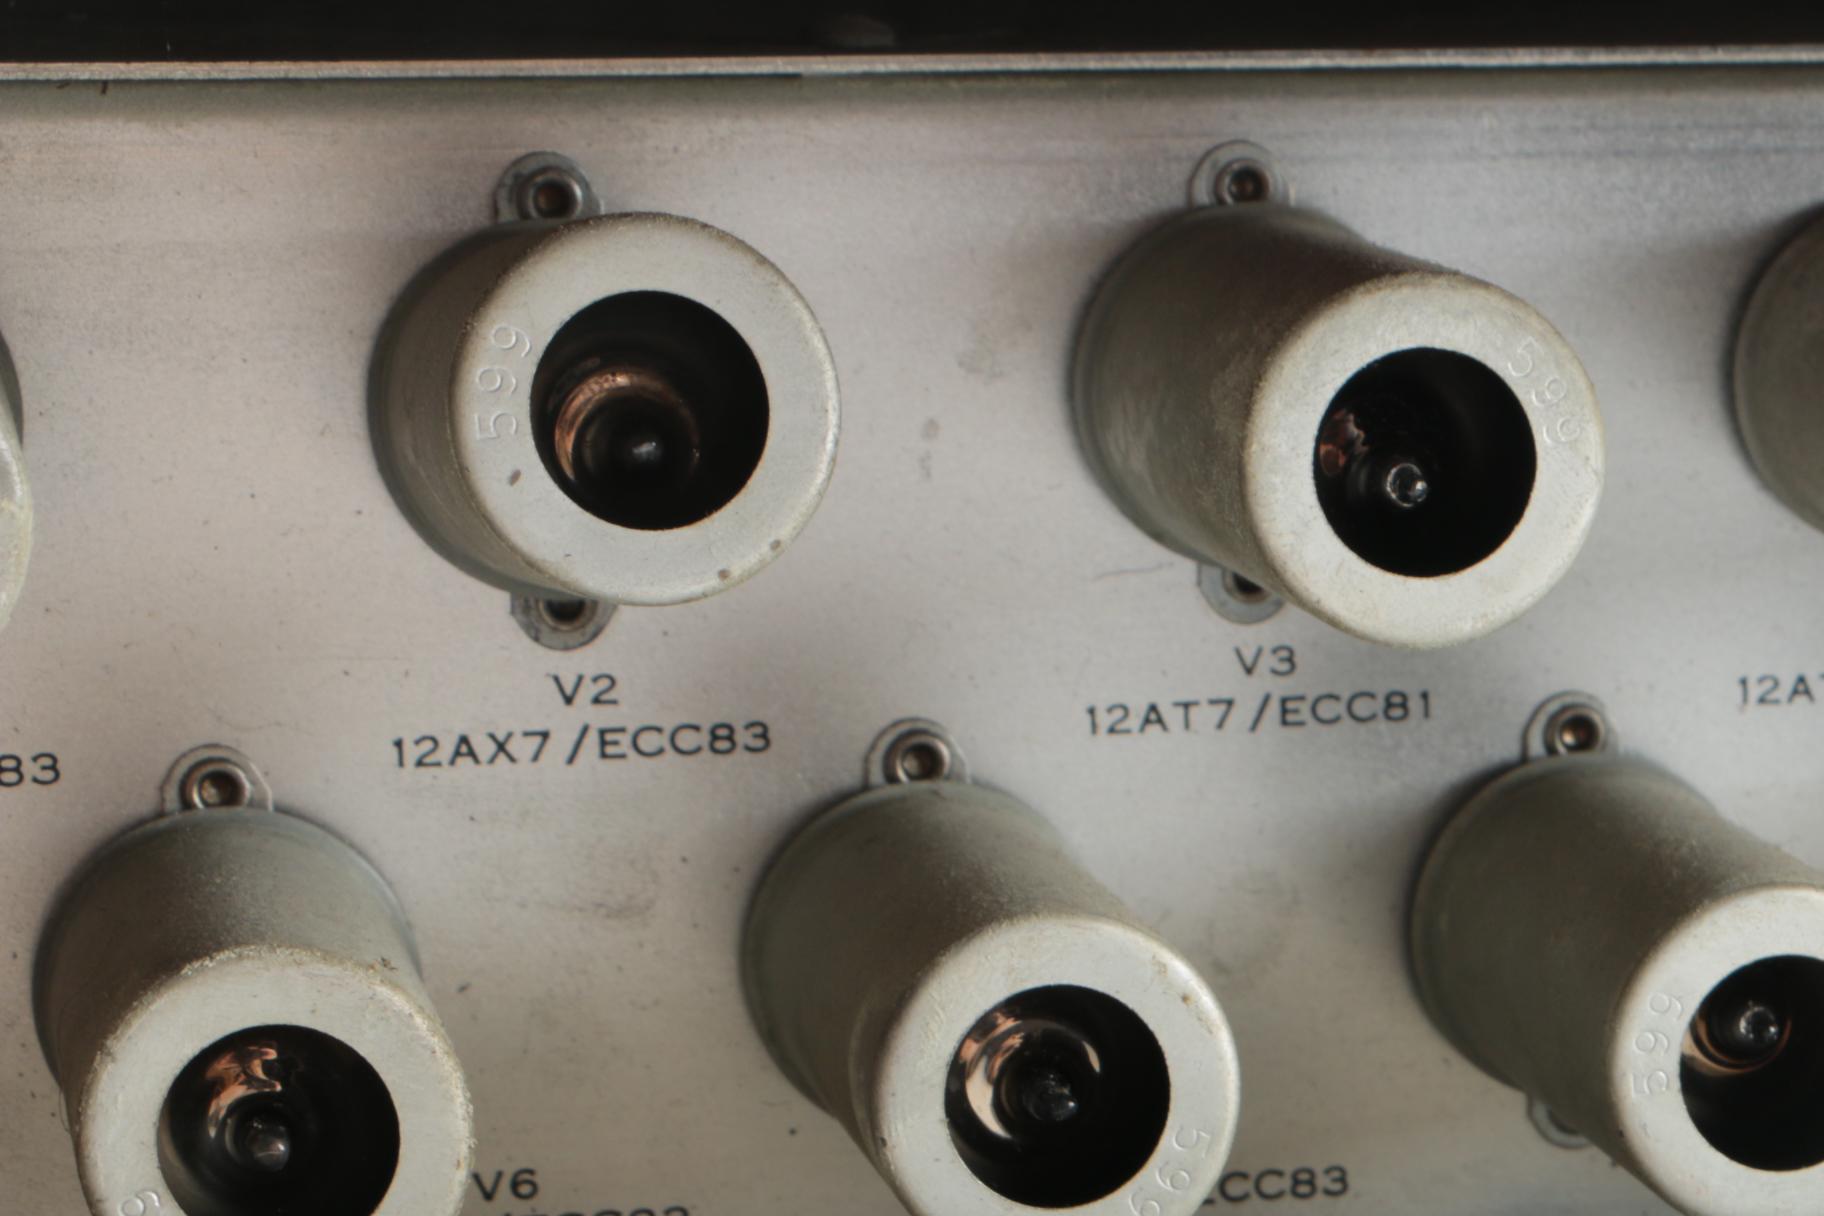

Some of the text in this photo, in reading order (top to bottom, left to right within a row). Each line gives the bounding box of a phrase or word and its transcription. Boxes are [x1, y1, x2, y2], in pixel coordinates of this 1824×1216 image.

[474, 325, 532, 442] 599
[1234, 645, 1298, 676] V3
[551, 673, 619, 706] V2
[1086, 690, 1431, 735] 12AT7/ECC81
[392, 720, 772, 768] 12AX7/ECC83
[473, 1168, 538, 1201] V6
[1201, 1165, 1348, 1205] CC83
